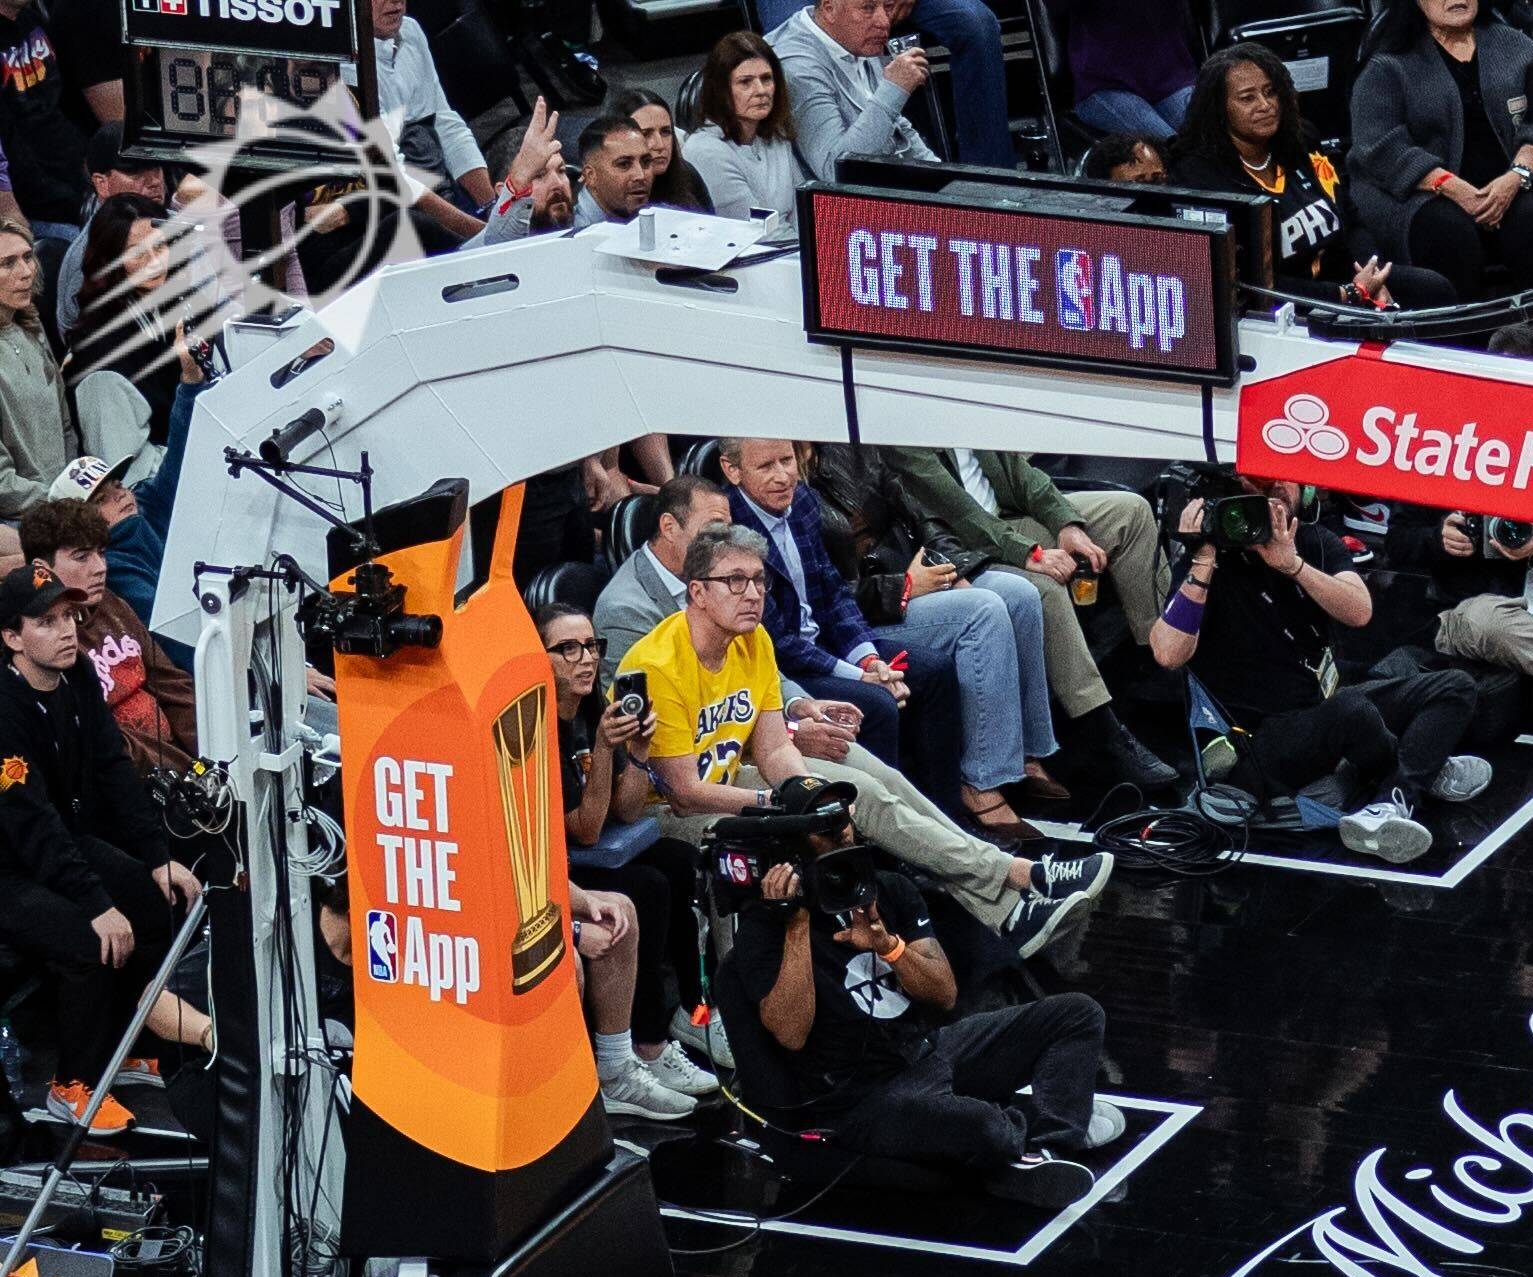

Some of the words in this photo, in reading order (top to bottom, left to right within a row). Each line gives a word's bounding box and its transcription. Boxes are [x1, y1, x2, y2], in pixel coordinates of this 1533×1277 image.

[200, 0, 341, 28] TISSOT
[847, 227, 938, 313] GET
[948, 238, 1045, 325] THE
[1098, 253, 1186, 353] App
[373, 756, 455, 834] GET
[376, 833, 462, 912] THE
[404, 916, 481, 1006] App
